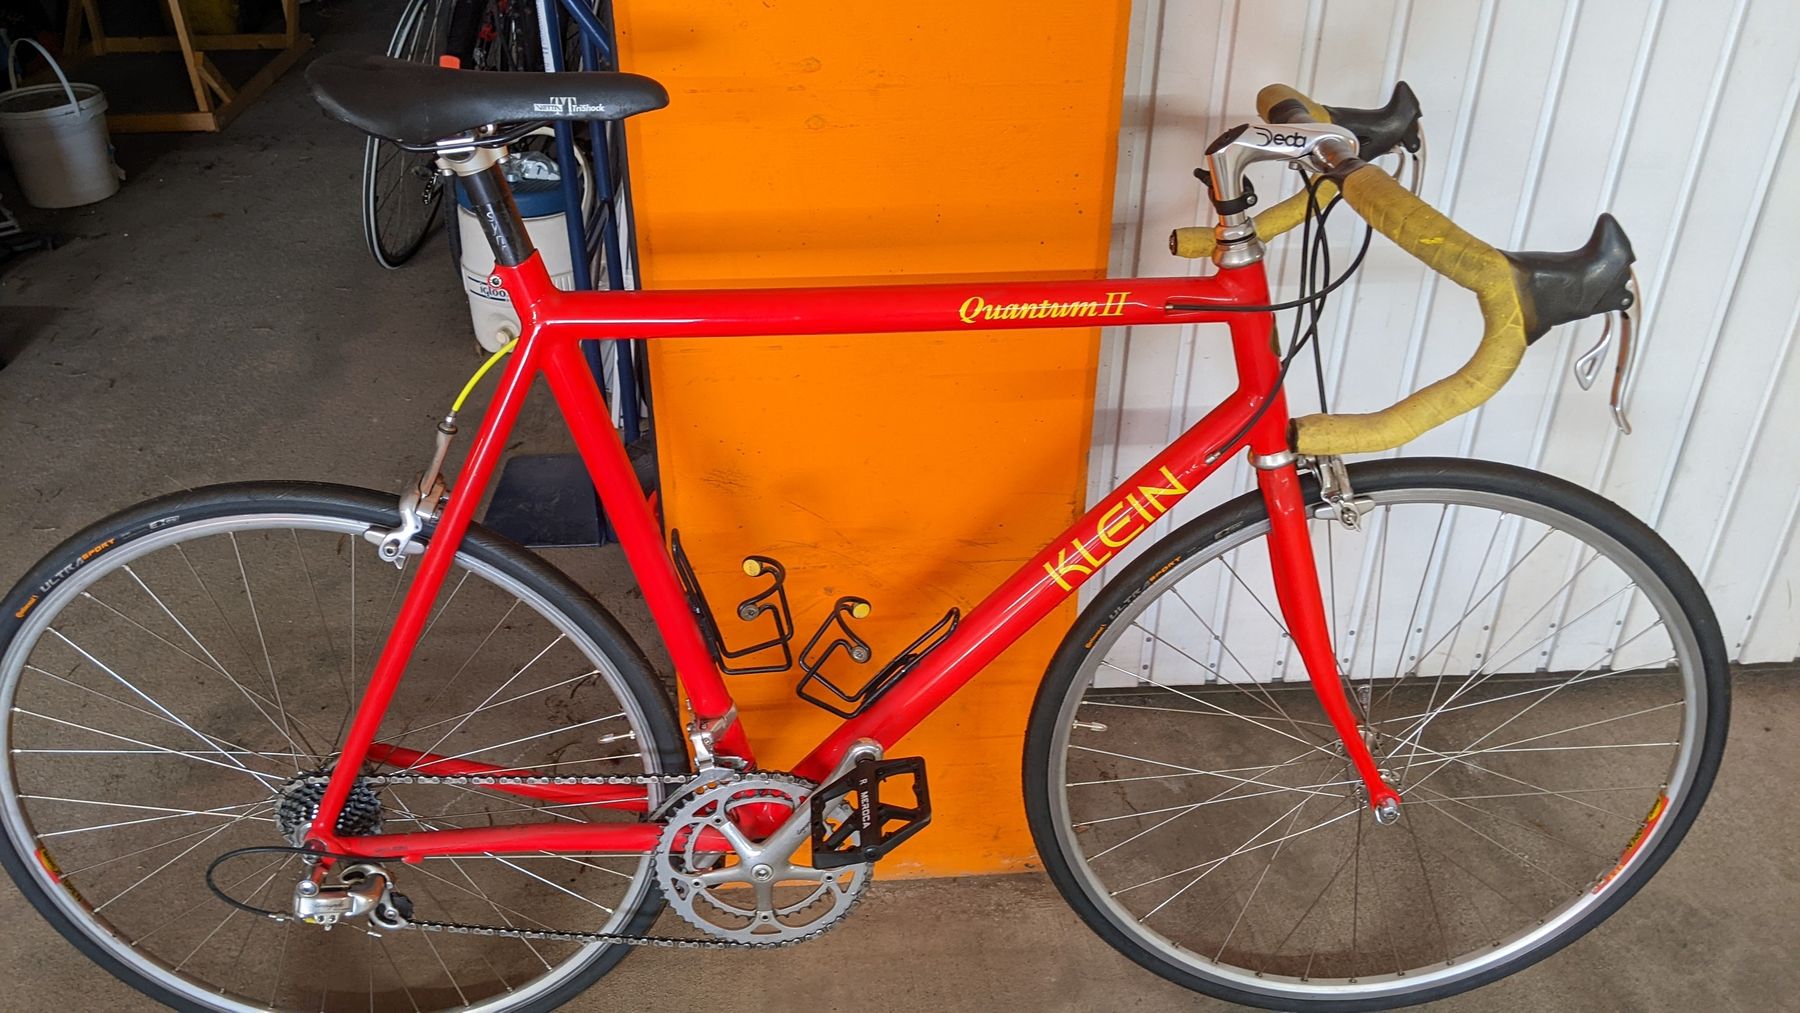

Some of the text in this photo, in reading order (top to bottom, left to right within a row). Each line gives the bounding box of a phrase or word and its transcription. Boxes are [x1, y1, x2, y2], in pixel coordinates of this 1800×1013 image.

[1253, 126, 1308, 148] Deda
[959, 291, 1132, 324] Quantum II
[1043, 465, 1189, 592] KLEIN
[860, 790, 872, 829] MEROCA
